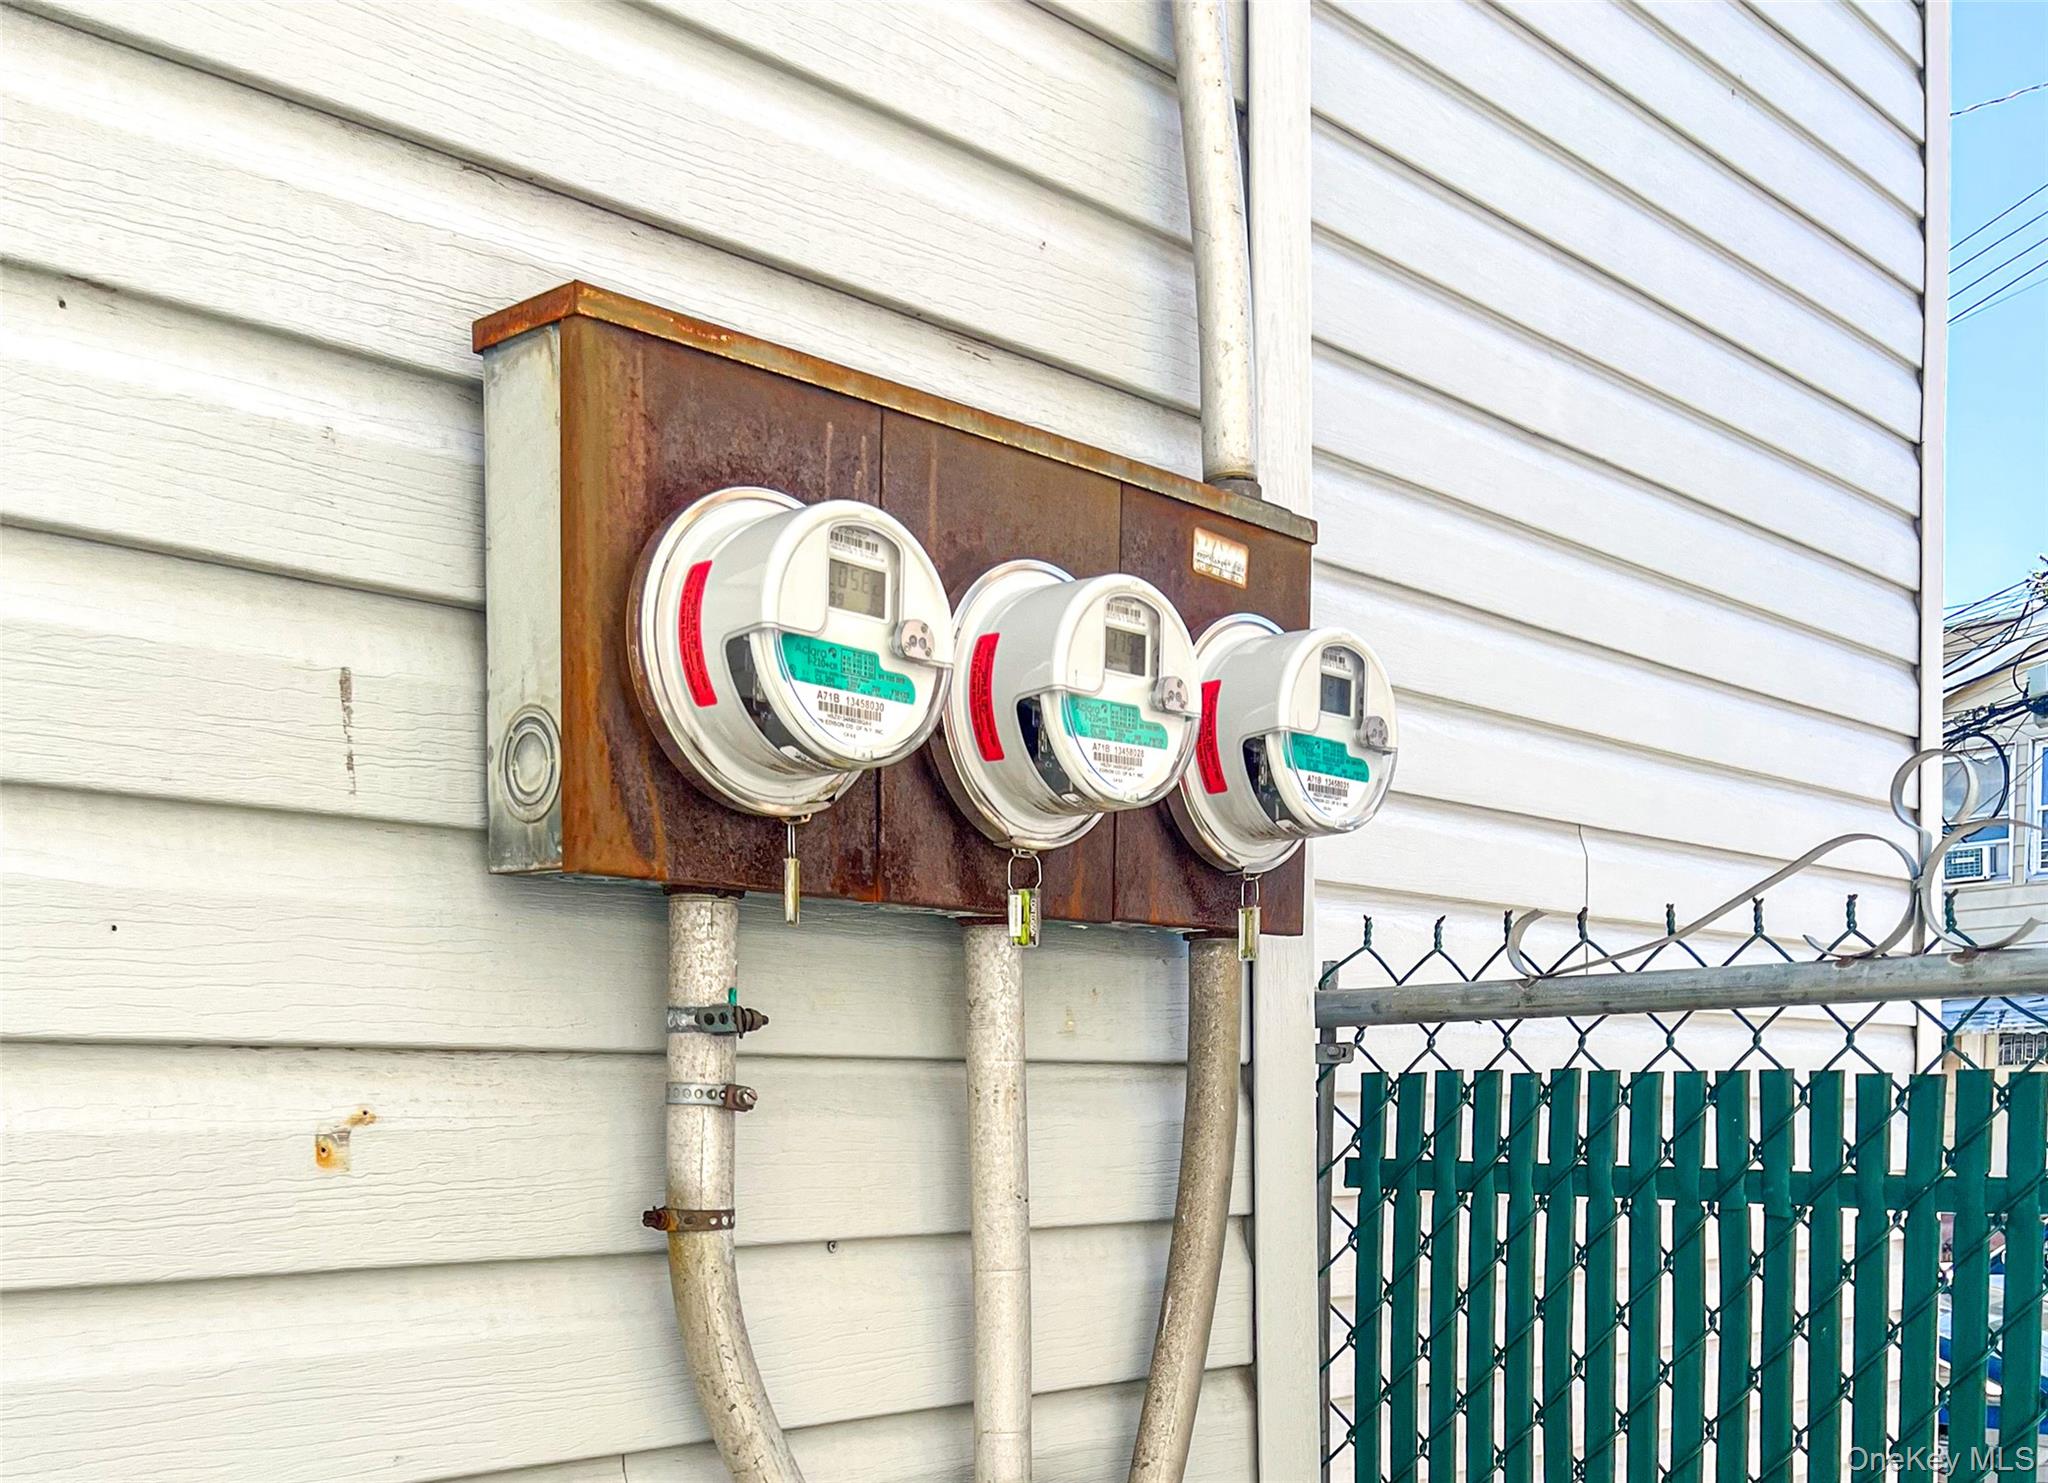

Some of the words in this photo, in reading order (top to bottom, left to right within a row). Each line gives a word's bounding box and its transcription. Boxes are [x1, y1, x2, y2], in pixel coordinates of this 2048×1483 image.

[817, 690, 840, 703] A71B
[846, 696, 885, 712] 13458030
[1092, 742, 1111, 753] A71B
[1307, 775, 1322, 784] A71B
